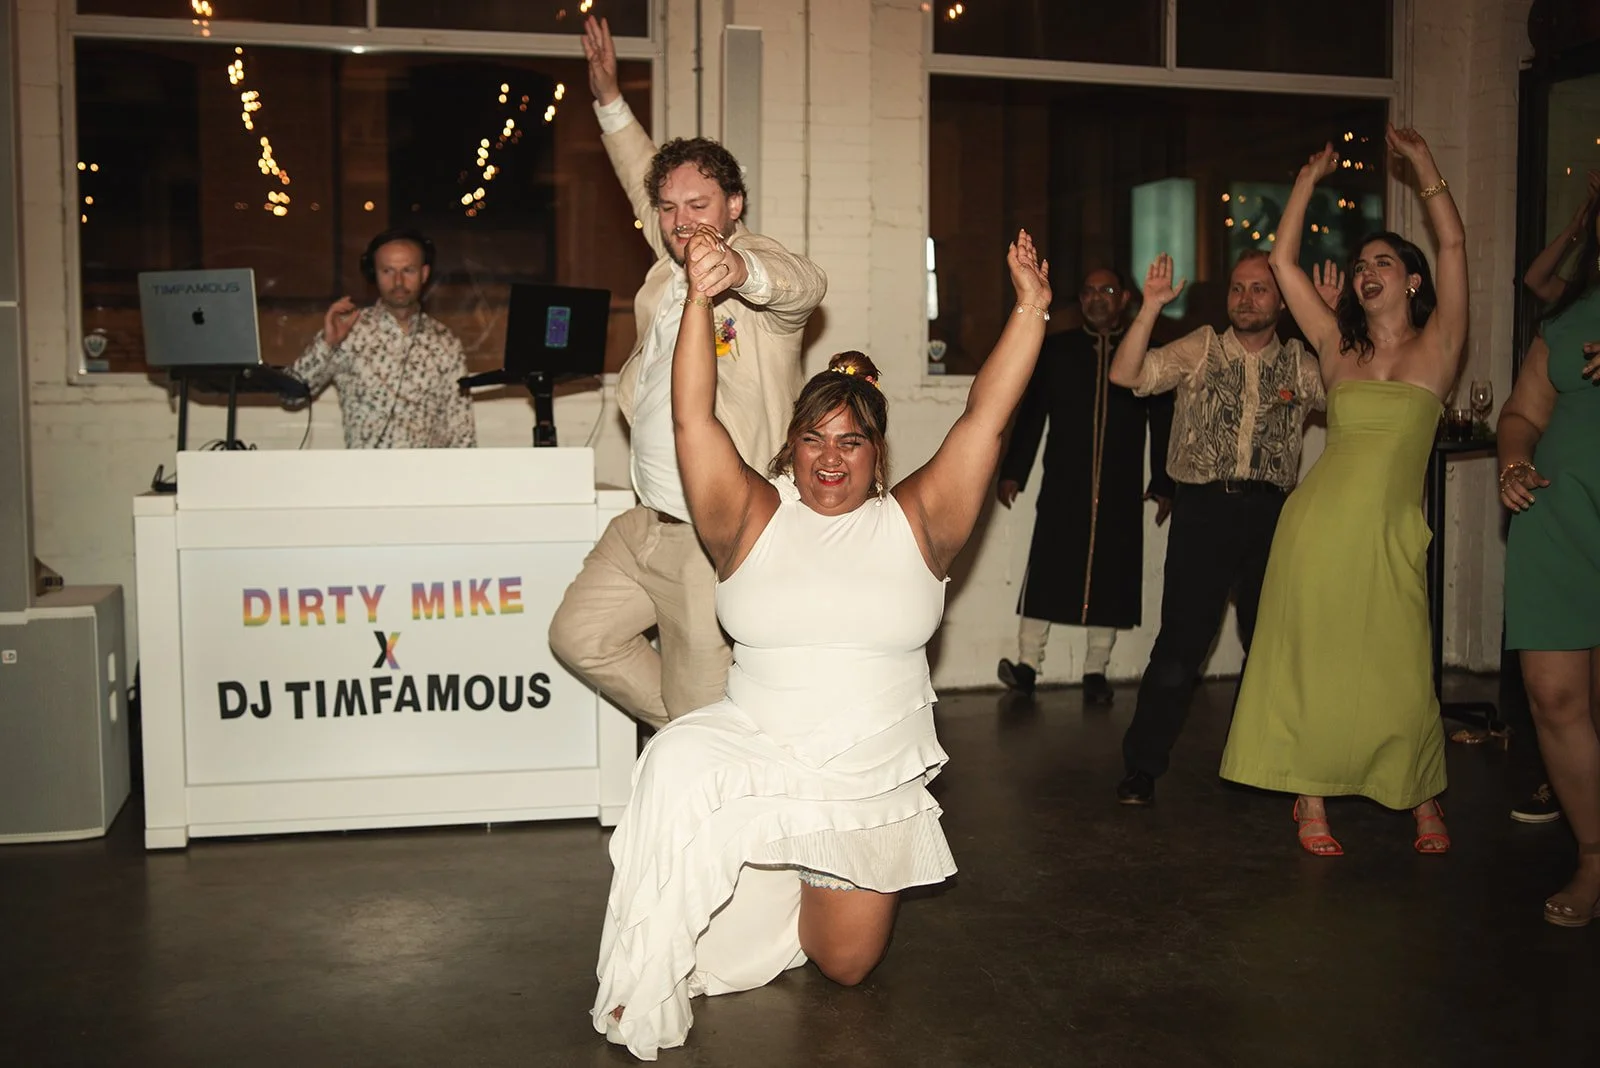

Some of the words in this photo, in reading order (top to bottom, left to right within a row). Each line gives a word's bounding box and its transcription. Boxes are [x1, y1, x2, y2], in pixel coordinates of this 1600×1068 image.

[242, 584, 386, 627] DIRTY
[411, 576, 524, 621] MIKE
[372, 630, 401, 670] X
[217, 680, 272, 720] DJ
[285, 672, 551, 720] TIMFAMOUS
